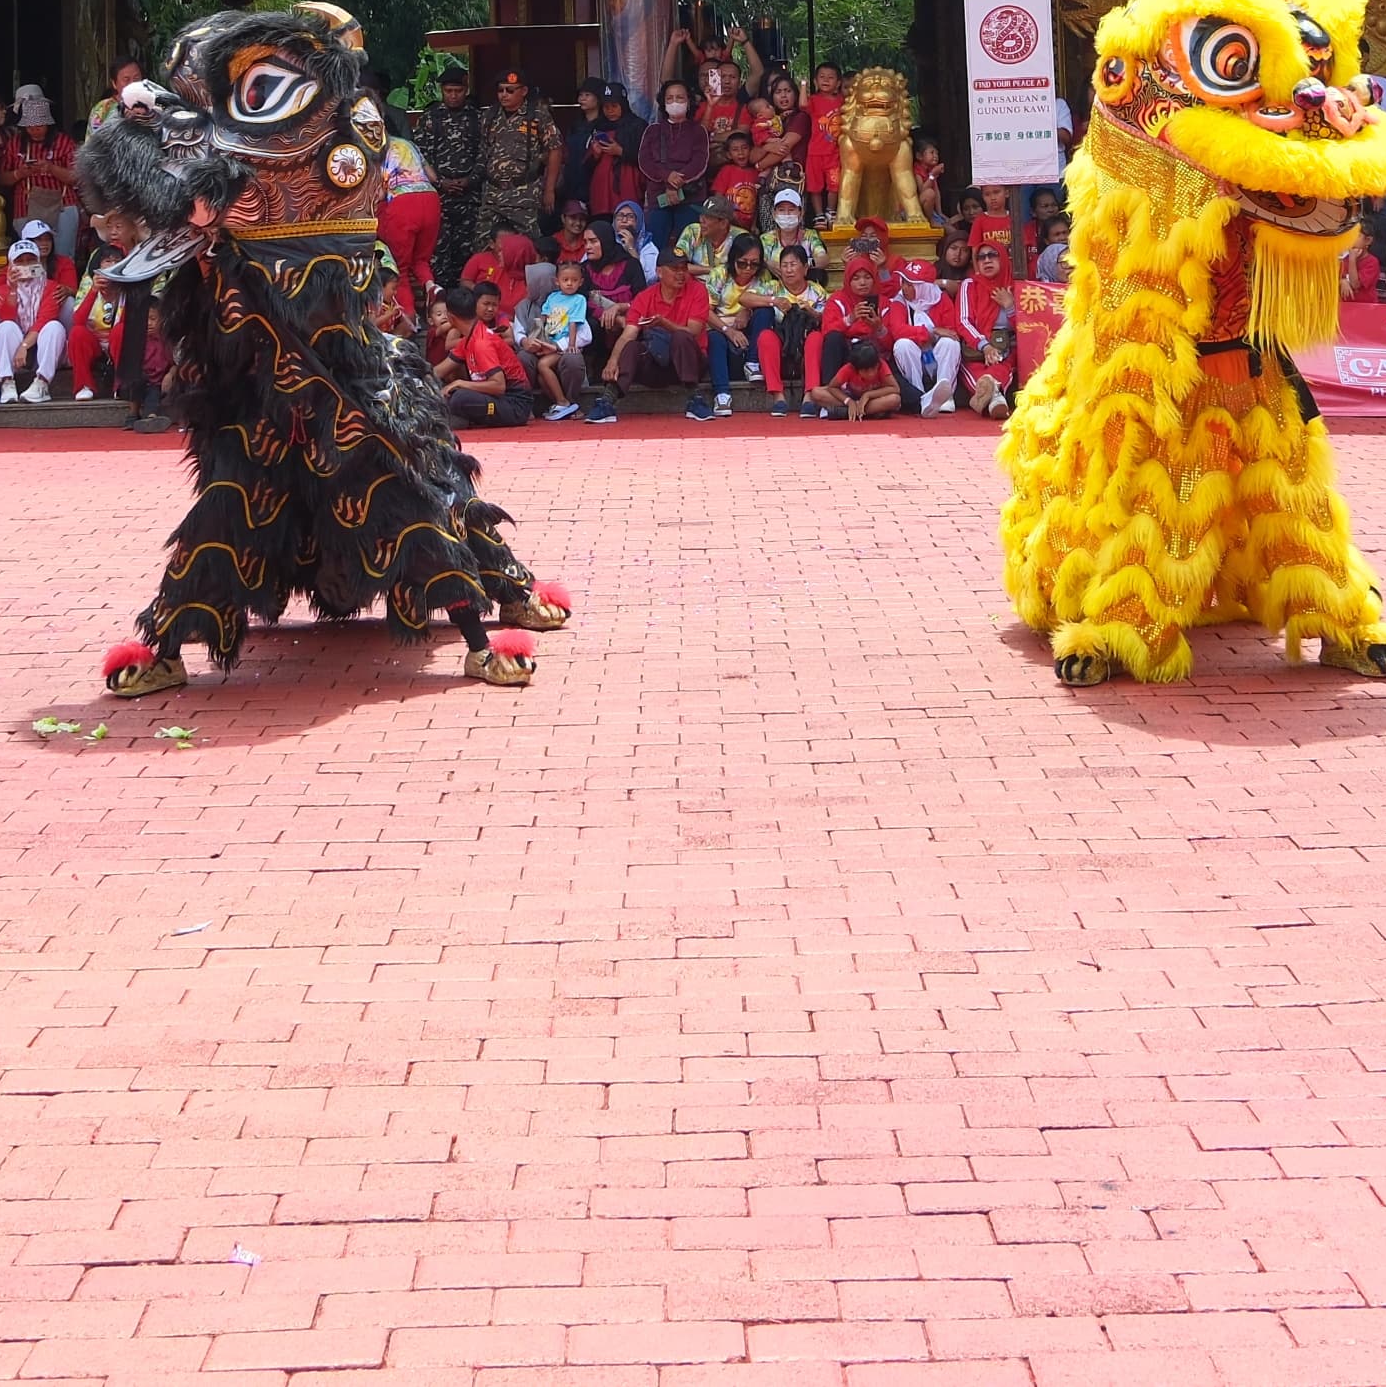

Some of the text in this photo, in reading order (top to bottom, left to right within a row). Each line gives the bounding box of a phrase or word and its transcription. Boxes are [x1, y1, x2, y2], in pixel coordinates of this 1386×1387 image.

[993, 80, 1011, 88] YOUR
[1012, 79, 1034, 87] PEACE
[1036, 78, 1047, 87] AT
[987, 95, 1039, 104] PESAREAN
[977, 105, 1050, 115] GUNUNG KAWI
